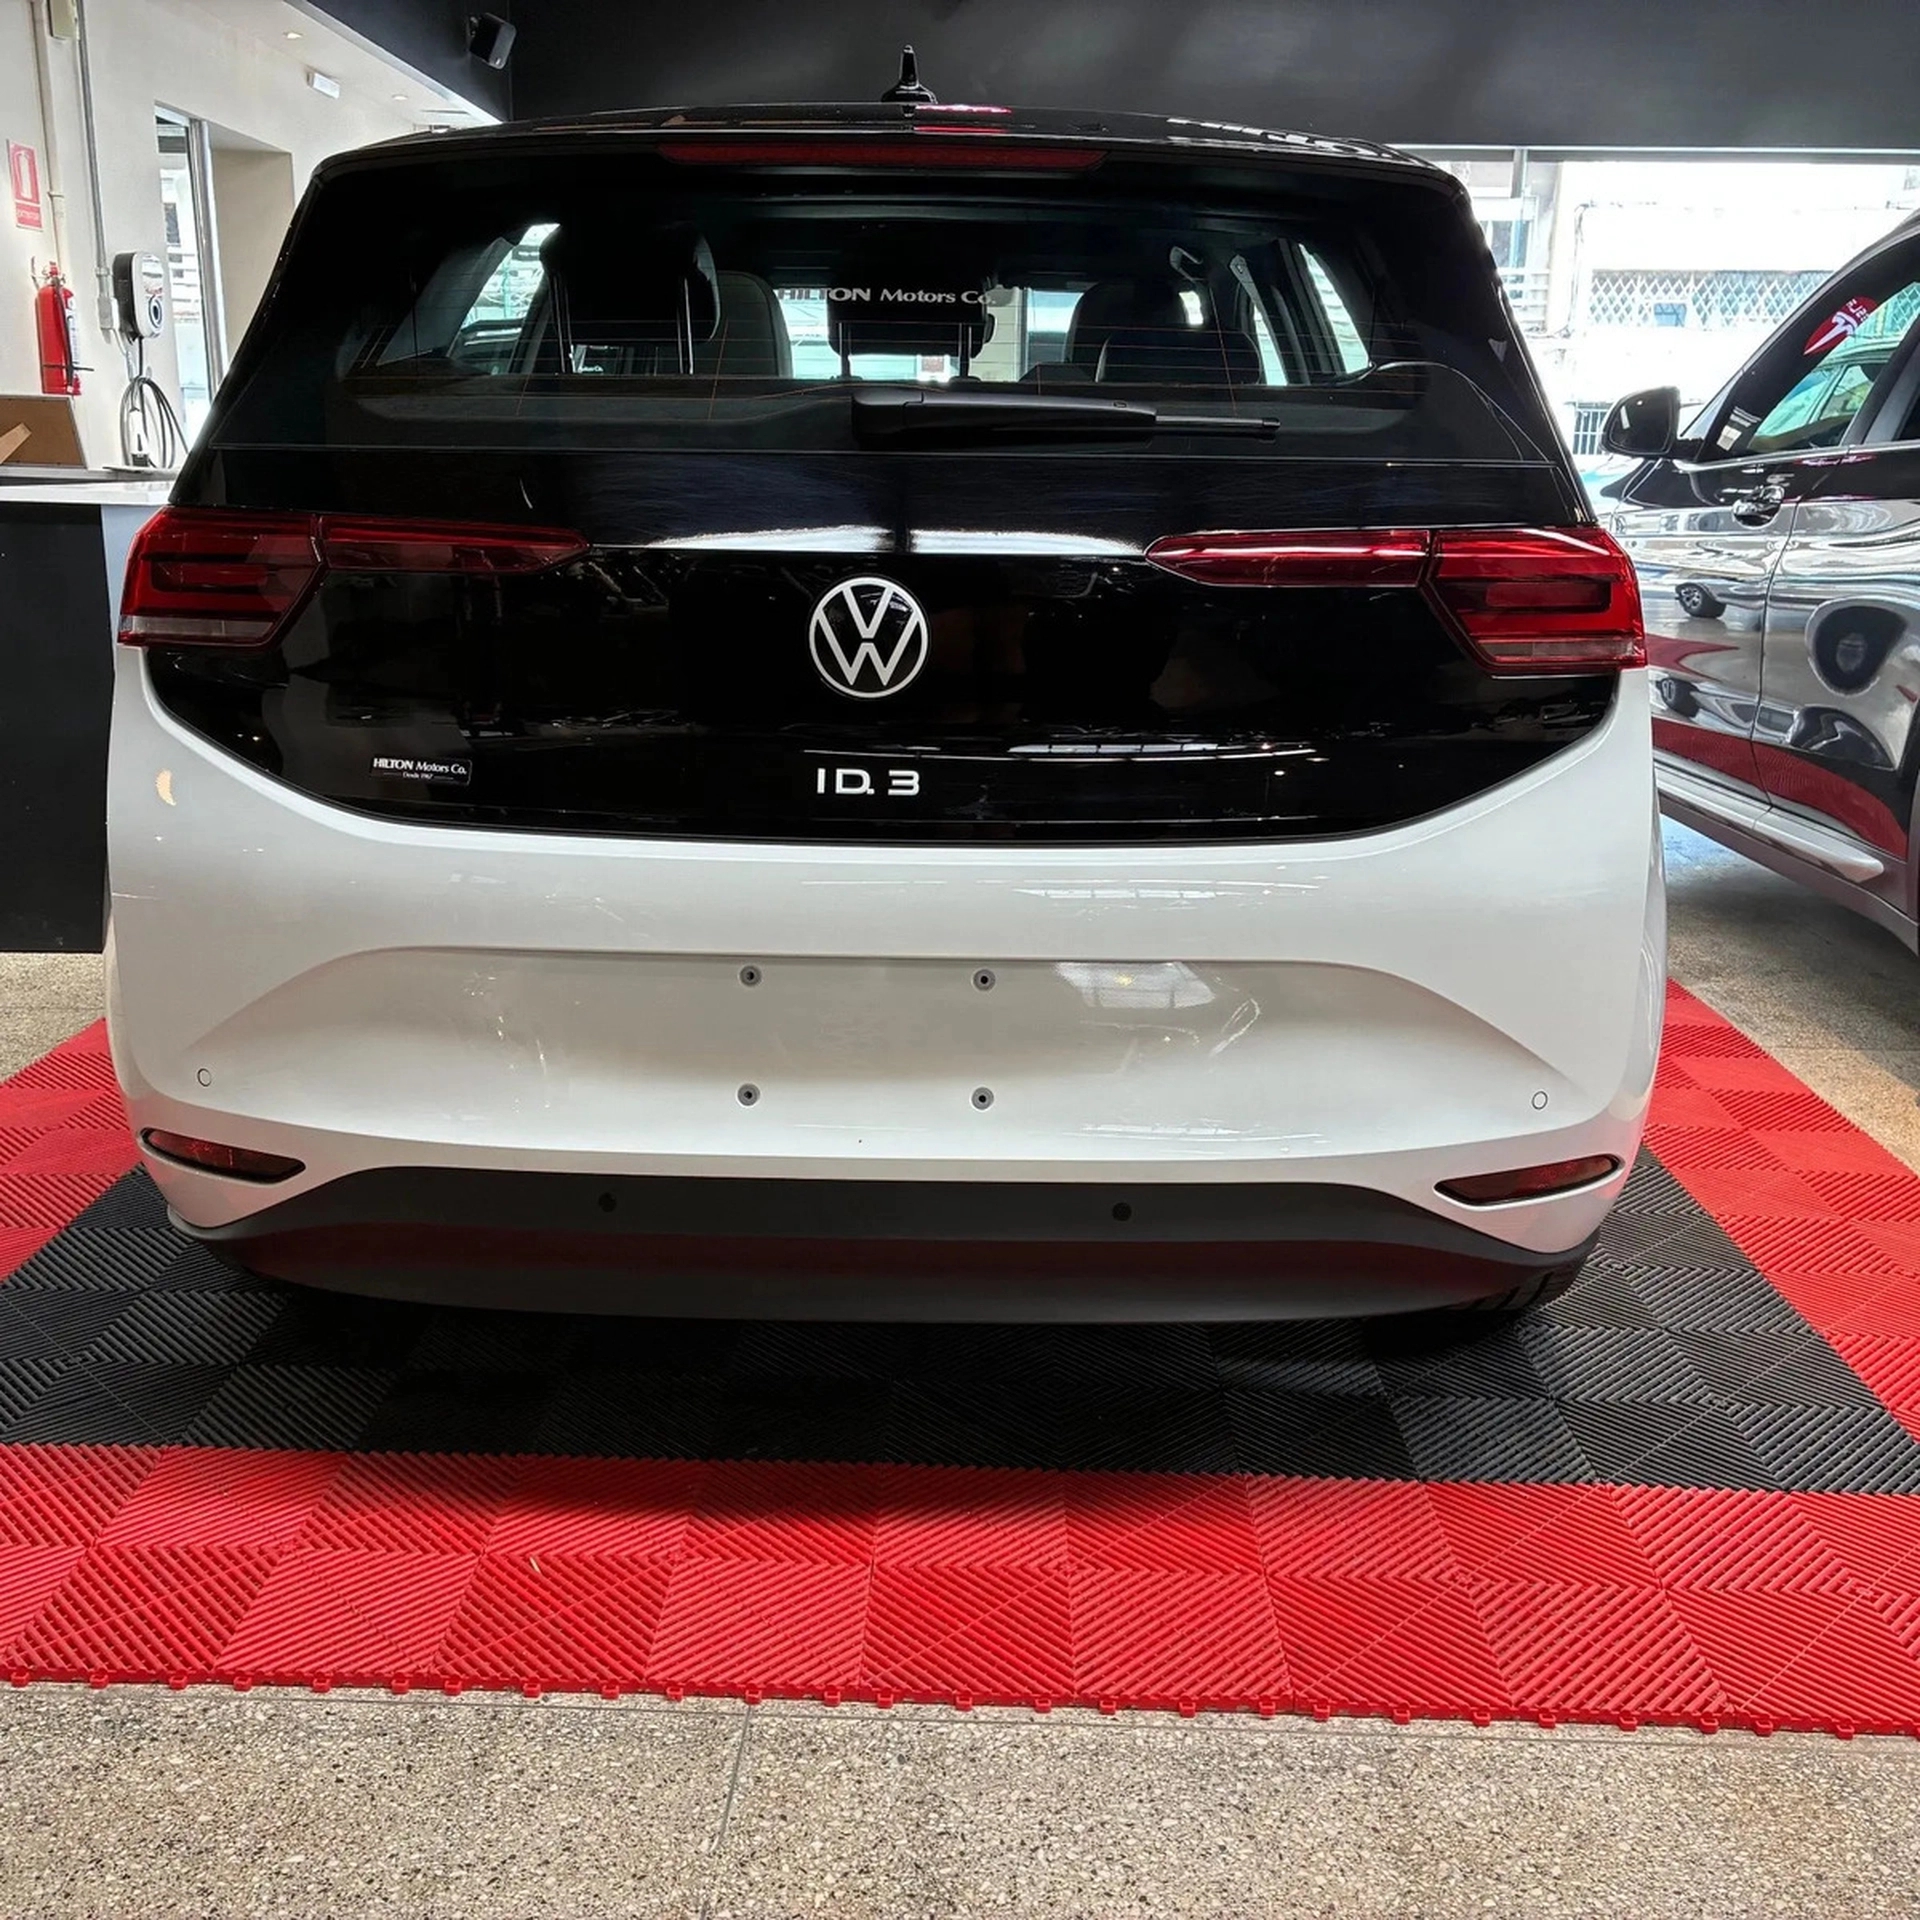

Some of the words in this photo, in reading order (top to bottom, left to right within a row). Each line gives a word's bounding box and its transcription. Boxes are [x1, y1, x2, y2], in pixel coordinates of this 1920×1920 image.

[777, 288, 871, 302] HILTON
[880, 288, 956, 304] Motors
[809, 577, 928, 698] VW
[373, 758, 414, 770] HILTON
[415, 761, 449, 773] Motors
[450, 763, 467, 775] Co.
